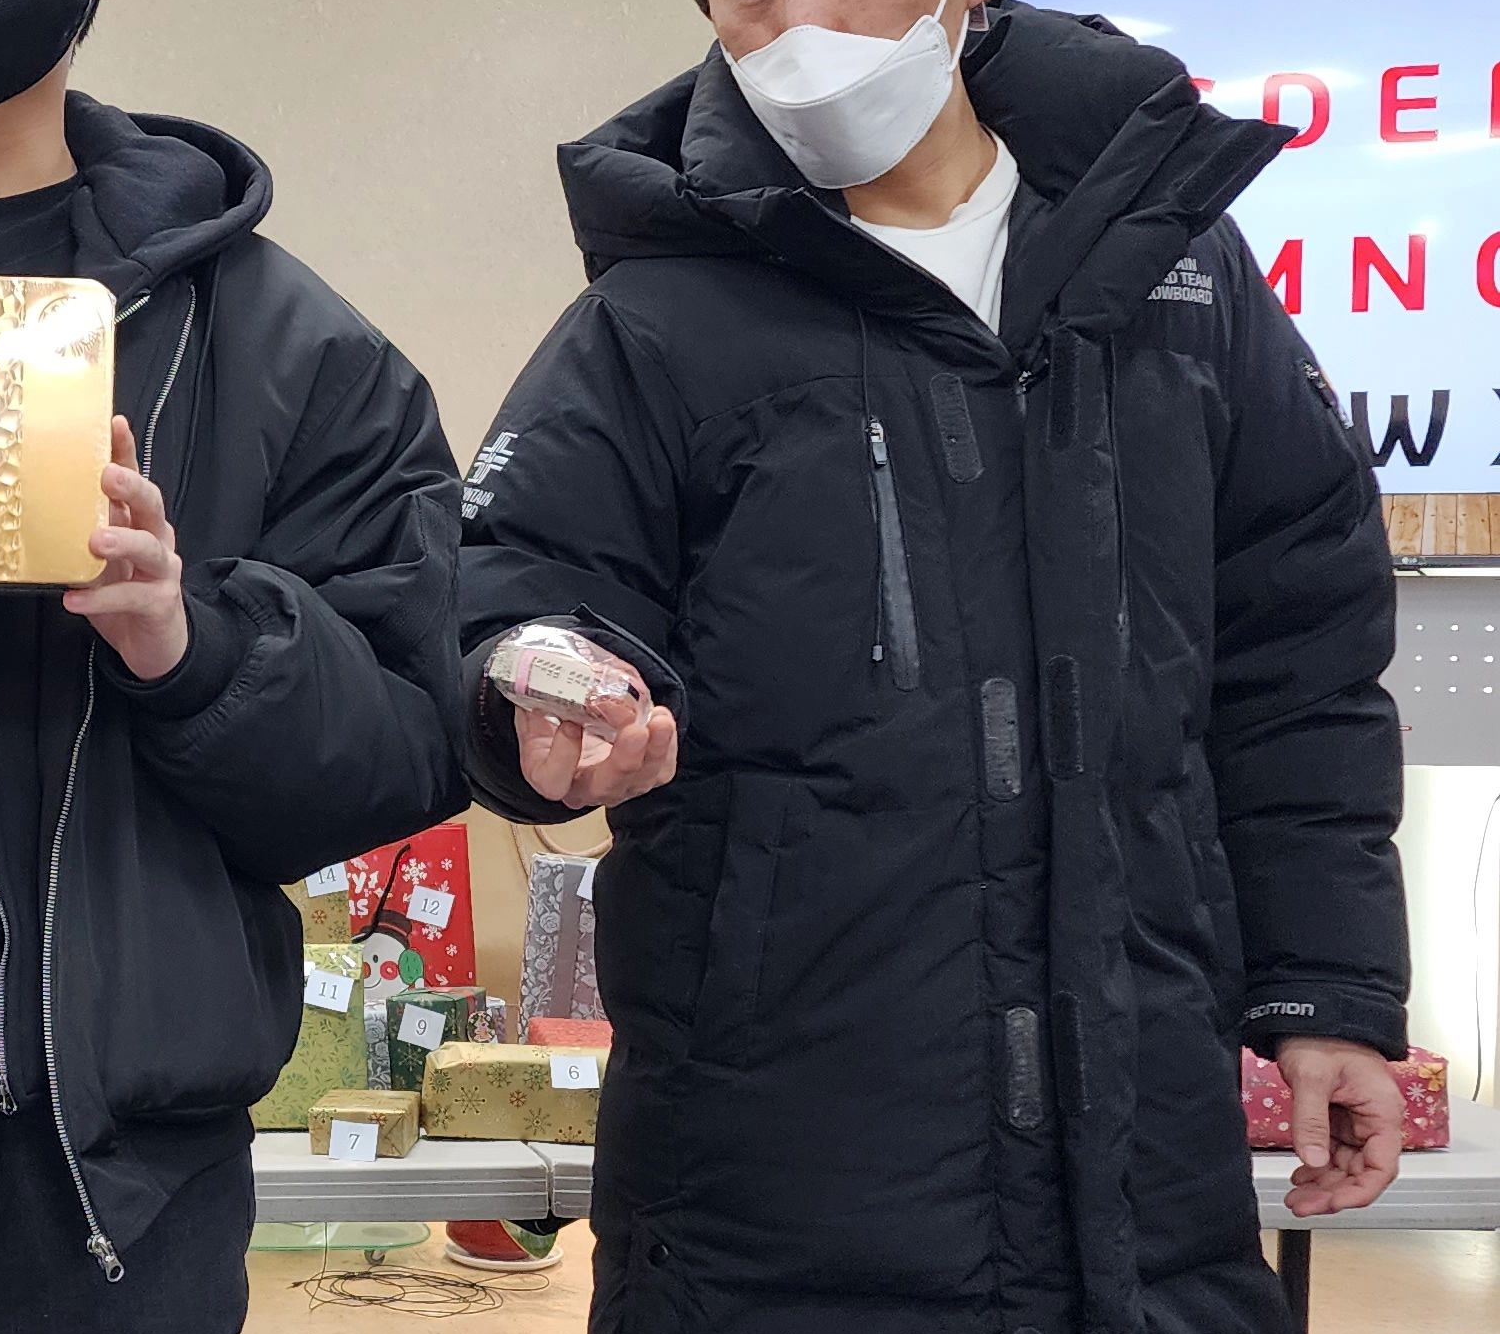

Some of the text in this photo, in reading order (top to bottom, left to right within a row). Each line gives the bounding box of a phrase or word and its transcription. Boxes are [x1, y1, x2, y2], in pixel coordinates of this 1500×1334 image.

[1179, 271, 1213, 290] TEAM
[1146, 285, 1213, 305] OWBOARD
[318, 867, 337, 884] 14
[420, 898, 442, 916] 12
[318, 981, 338, 1001] 11
[415, 1019, 428, 1036] 9
[568, 1065, 580, 1080] 6
[348, 1133, 361, 1150] 7
